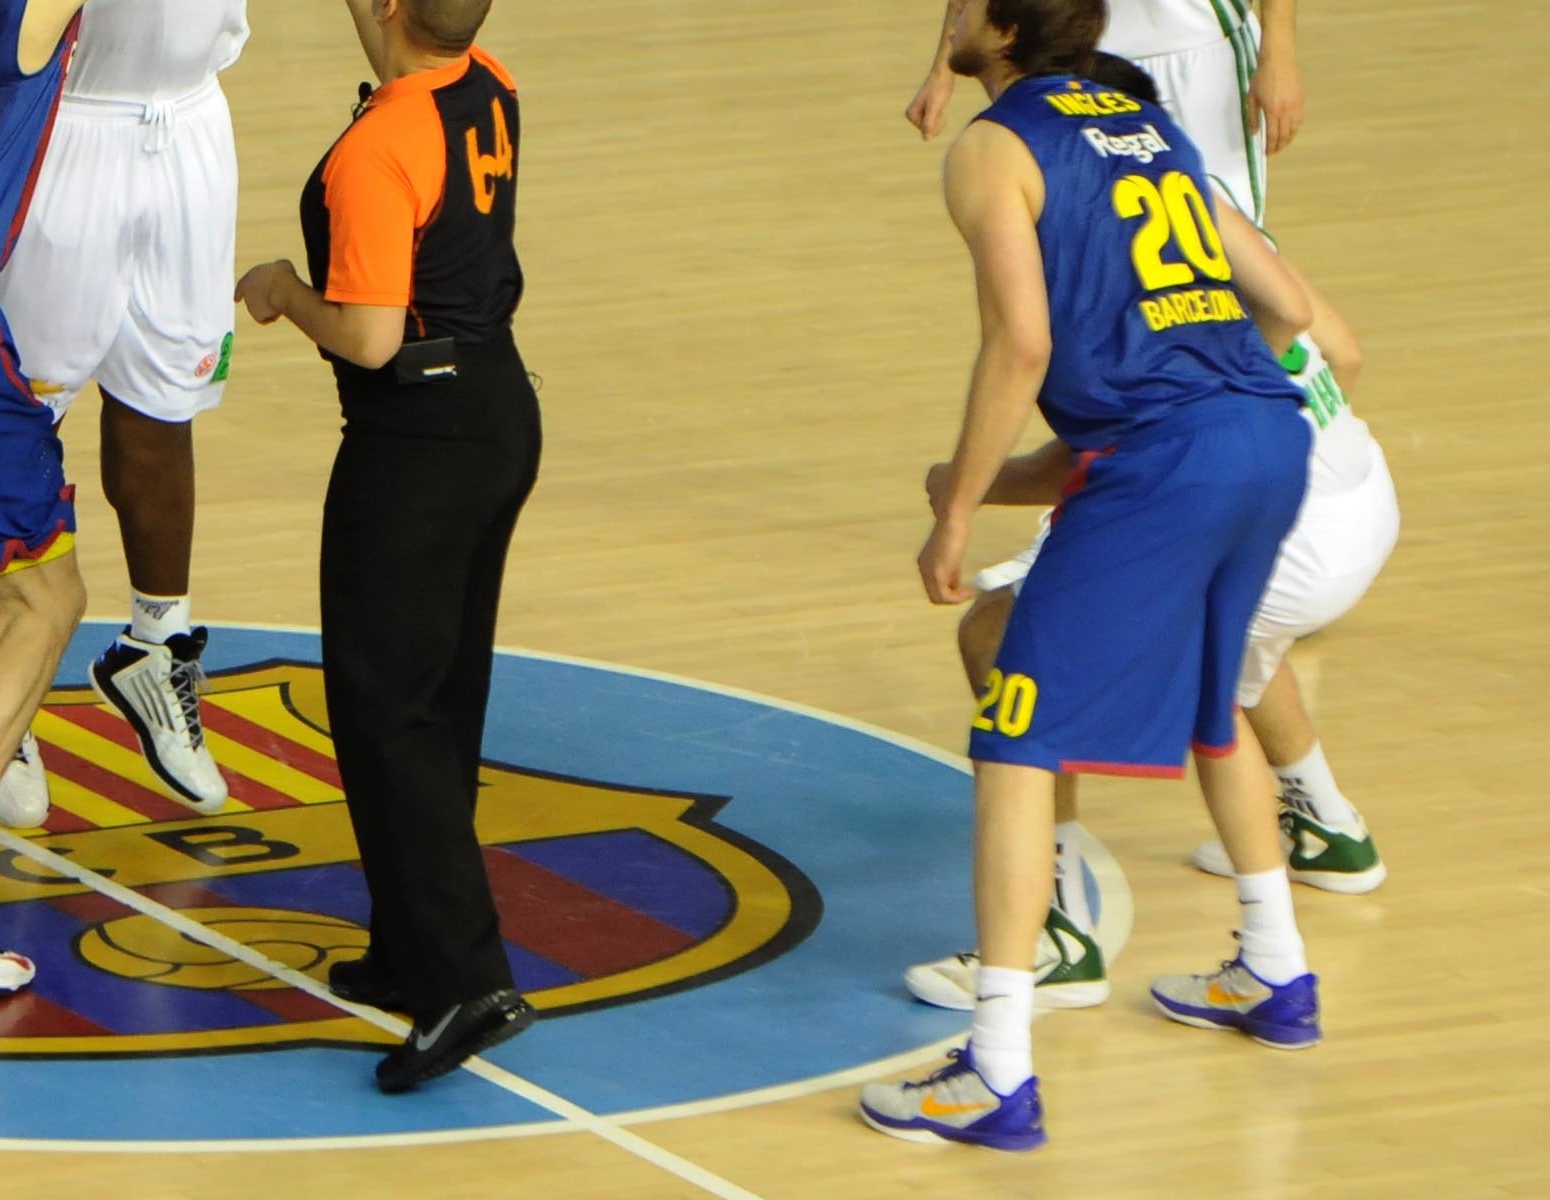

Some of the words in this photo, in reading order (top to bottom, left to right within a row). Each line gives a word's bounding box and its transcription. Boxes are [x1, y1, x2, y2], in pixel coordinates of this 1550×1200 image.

[1081, 123, 1172, 164] Regal
[1111, 170, 1233, 292] 20
[971, 666, 1039, 738] 20
